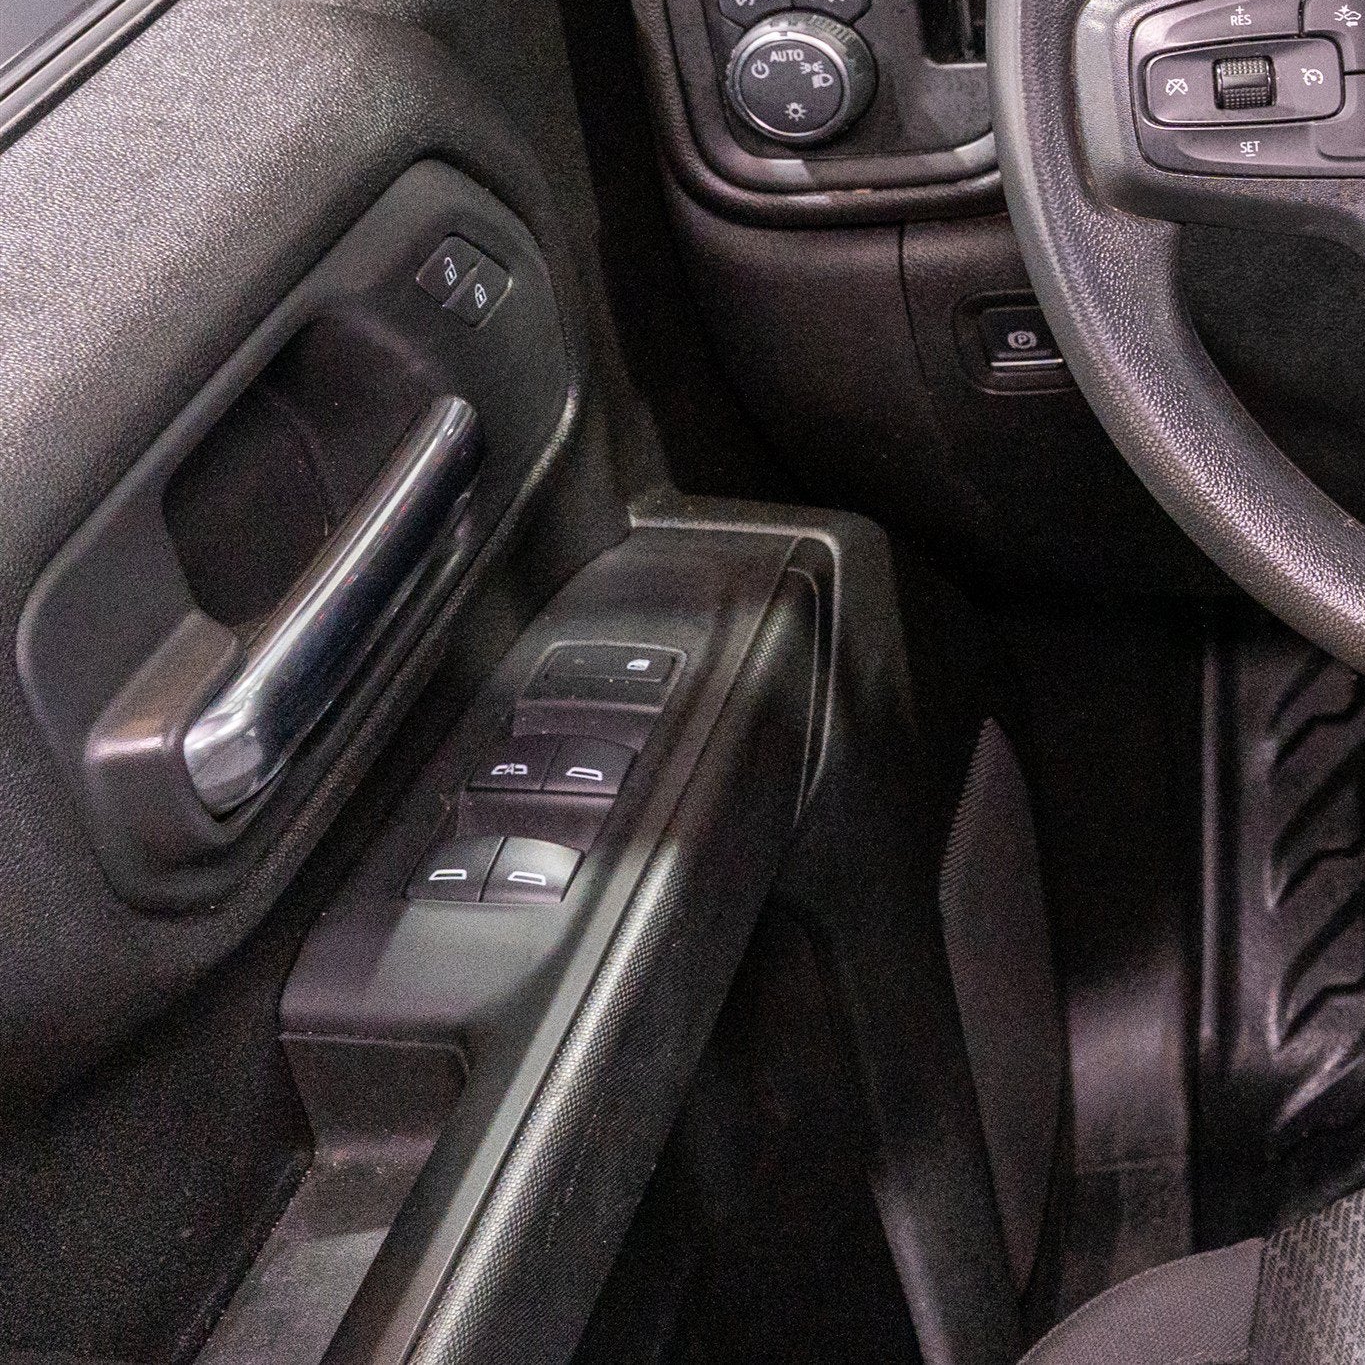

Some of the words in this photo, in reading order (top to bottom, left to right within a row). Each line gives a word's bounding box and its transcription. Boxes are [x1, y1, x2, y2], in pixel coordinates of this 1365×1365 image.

[1230, 14, 1252, 26] RES
[769, 49, 805, 62] AUTO
[1240, 140, 1260, 153] SET
